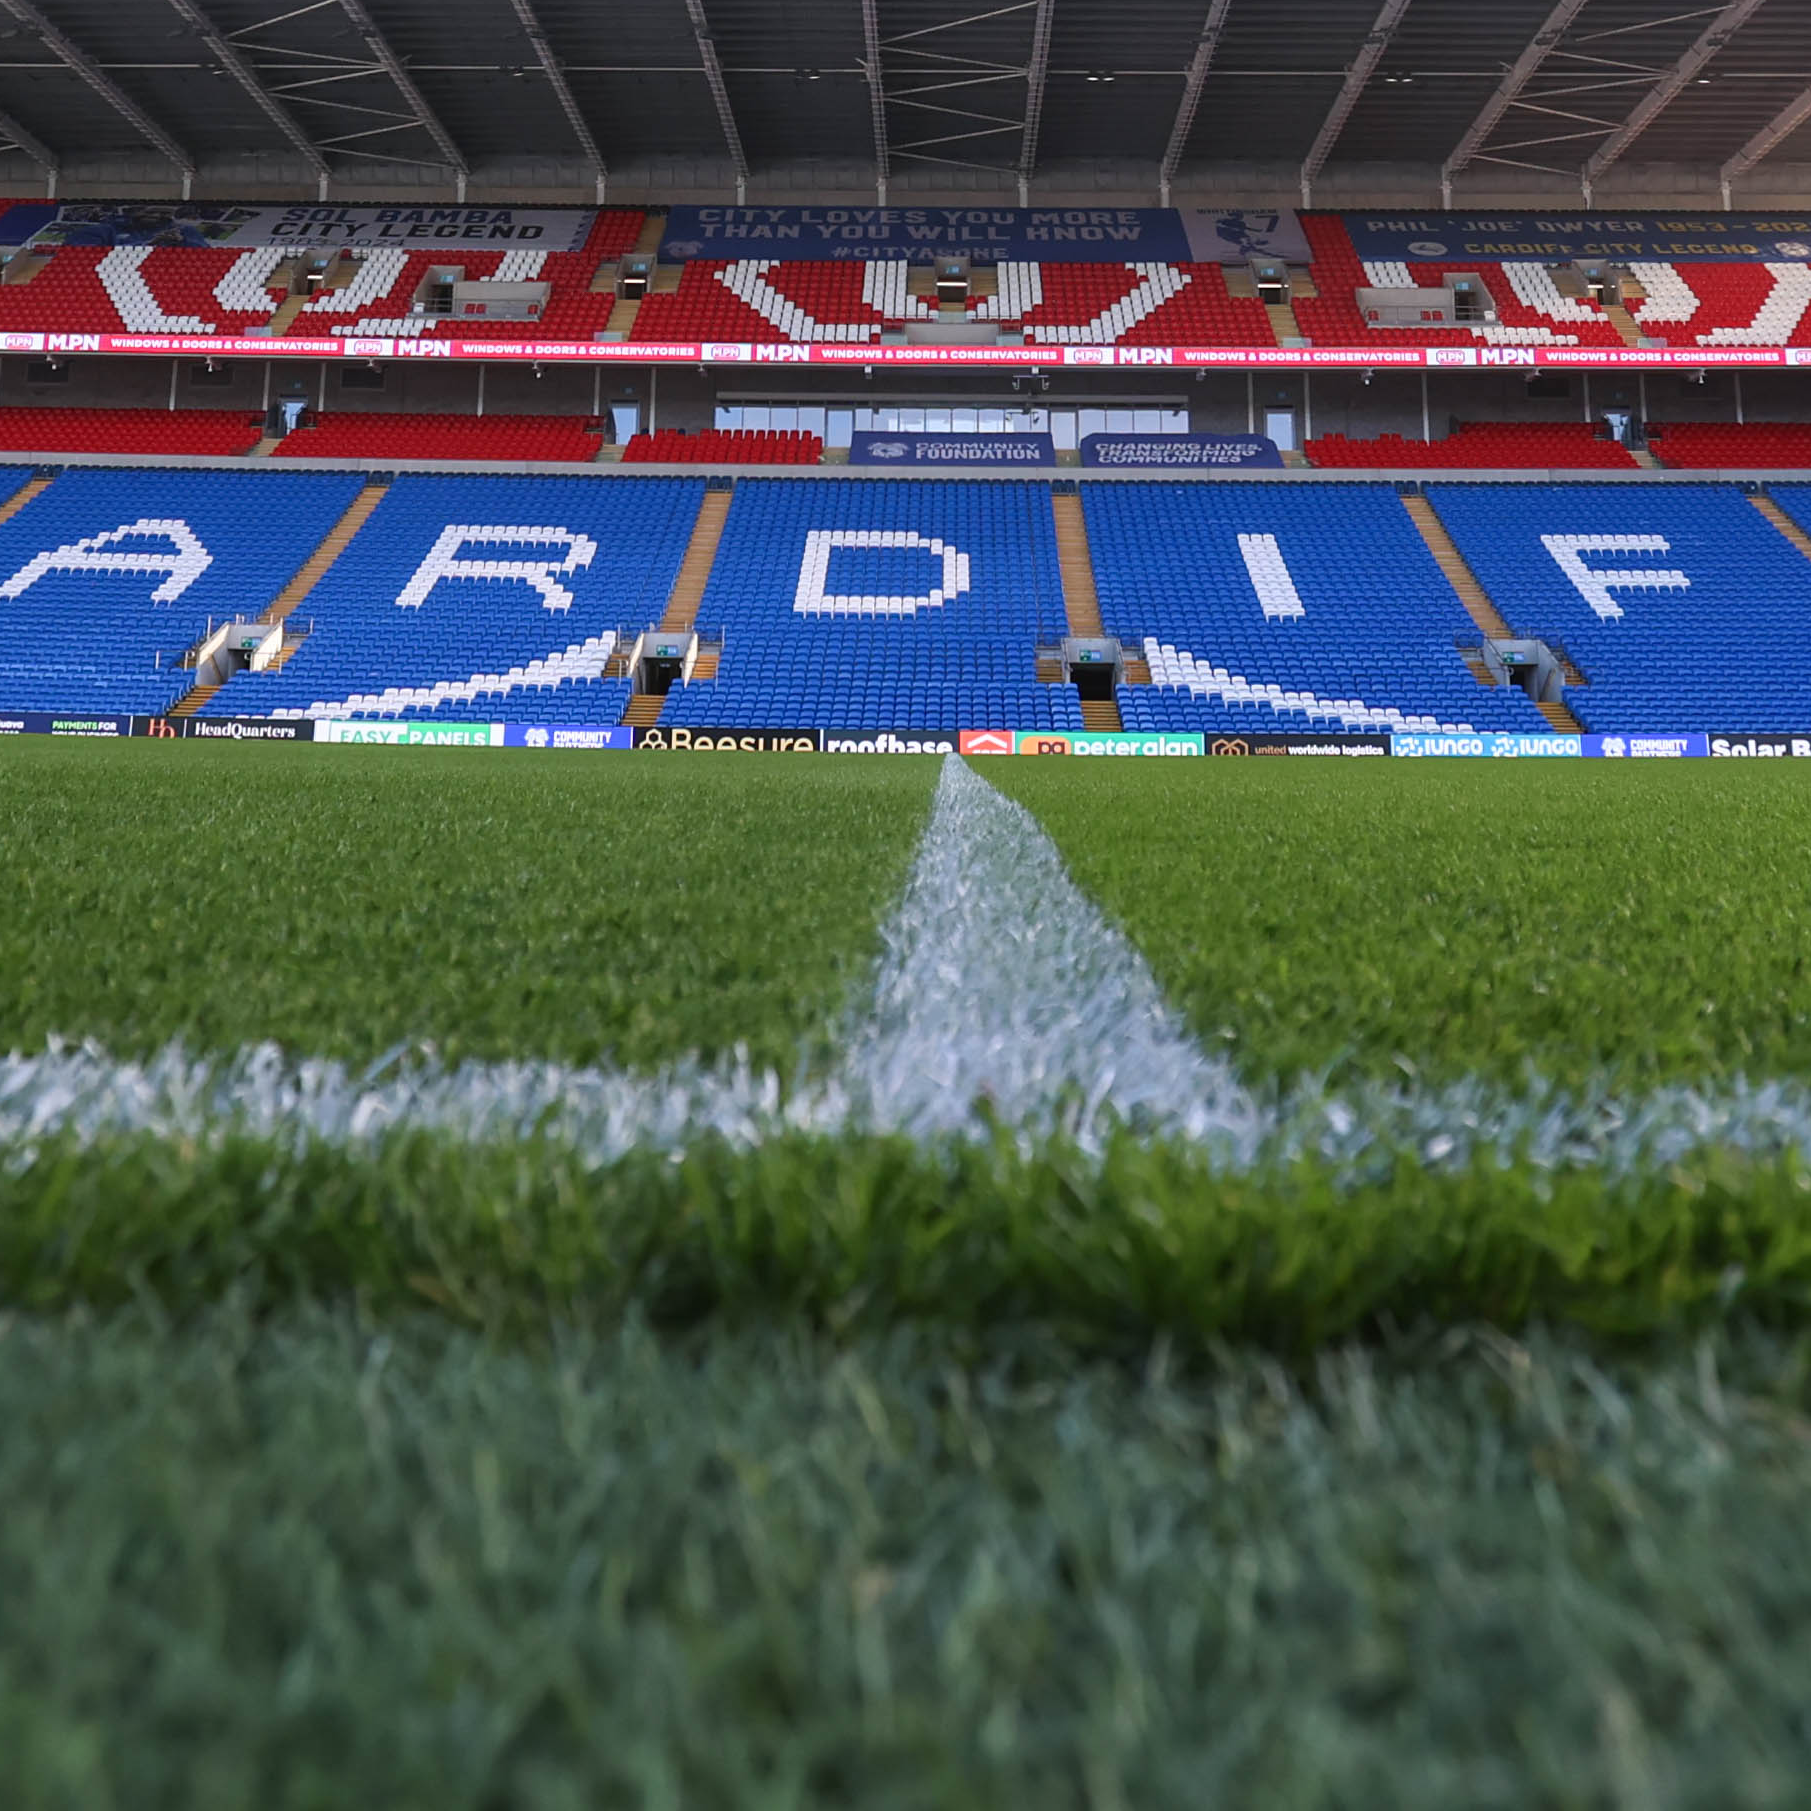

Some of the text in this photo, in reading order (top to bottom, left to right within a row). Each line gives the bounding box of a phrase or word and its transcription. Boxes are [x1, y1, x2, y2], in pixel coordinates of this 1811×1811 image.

[375, 209, 512, 224] BAMBA
[699, 209, 1141, 226] CITY LOVES YOU MORE
[271, 223, 544, 239] CITY LEGEND
[700, 224, 1142, 241] THAN YOU WILL KNOW
[1367, 220, 1439, 232] PHIL
[1538, 221, 1645, 233] DWYER
[1464, 243, 1576, 255] CARDIFF
[1653, 242, 1760, 255] LEGEND
[462, 344, 523, 354] WINDOWS
[589, 346, 695, 356] CONSERVATORIES
[1184, 352, 1246, 362] WINDOWS
[1313, 352, 1420, 362] CONSERVATORIES
[916, 449, 1041, 461] FOUNDATION
[52, 721, 117, 731] PAYMENTS FOR
[195, 722, 296, 739] HeadQuarters
[409, 731, 486, 746] PANELS
[553, 730, 612, 742] COMMUNITY
[671, 728, 814, 751] Beesure
[1255, 744, 1384, 756] united worldwide logistics
[1630, 739, 1688, 750] COMMUNITY
[1712, 739, 1786, 756] Solar
